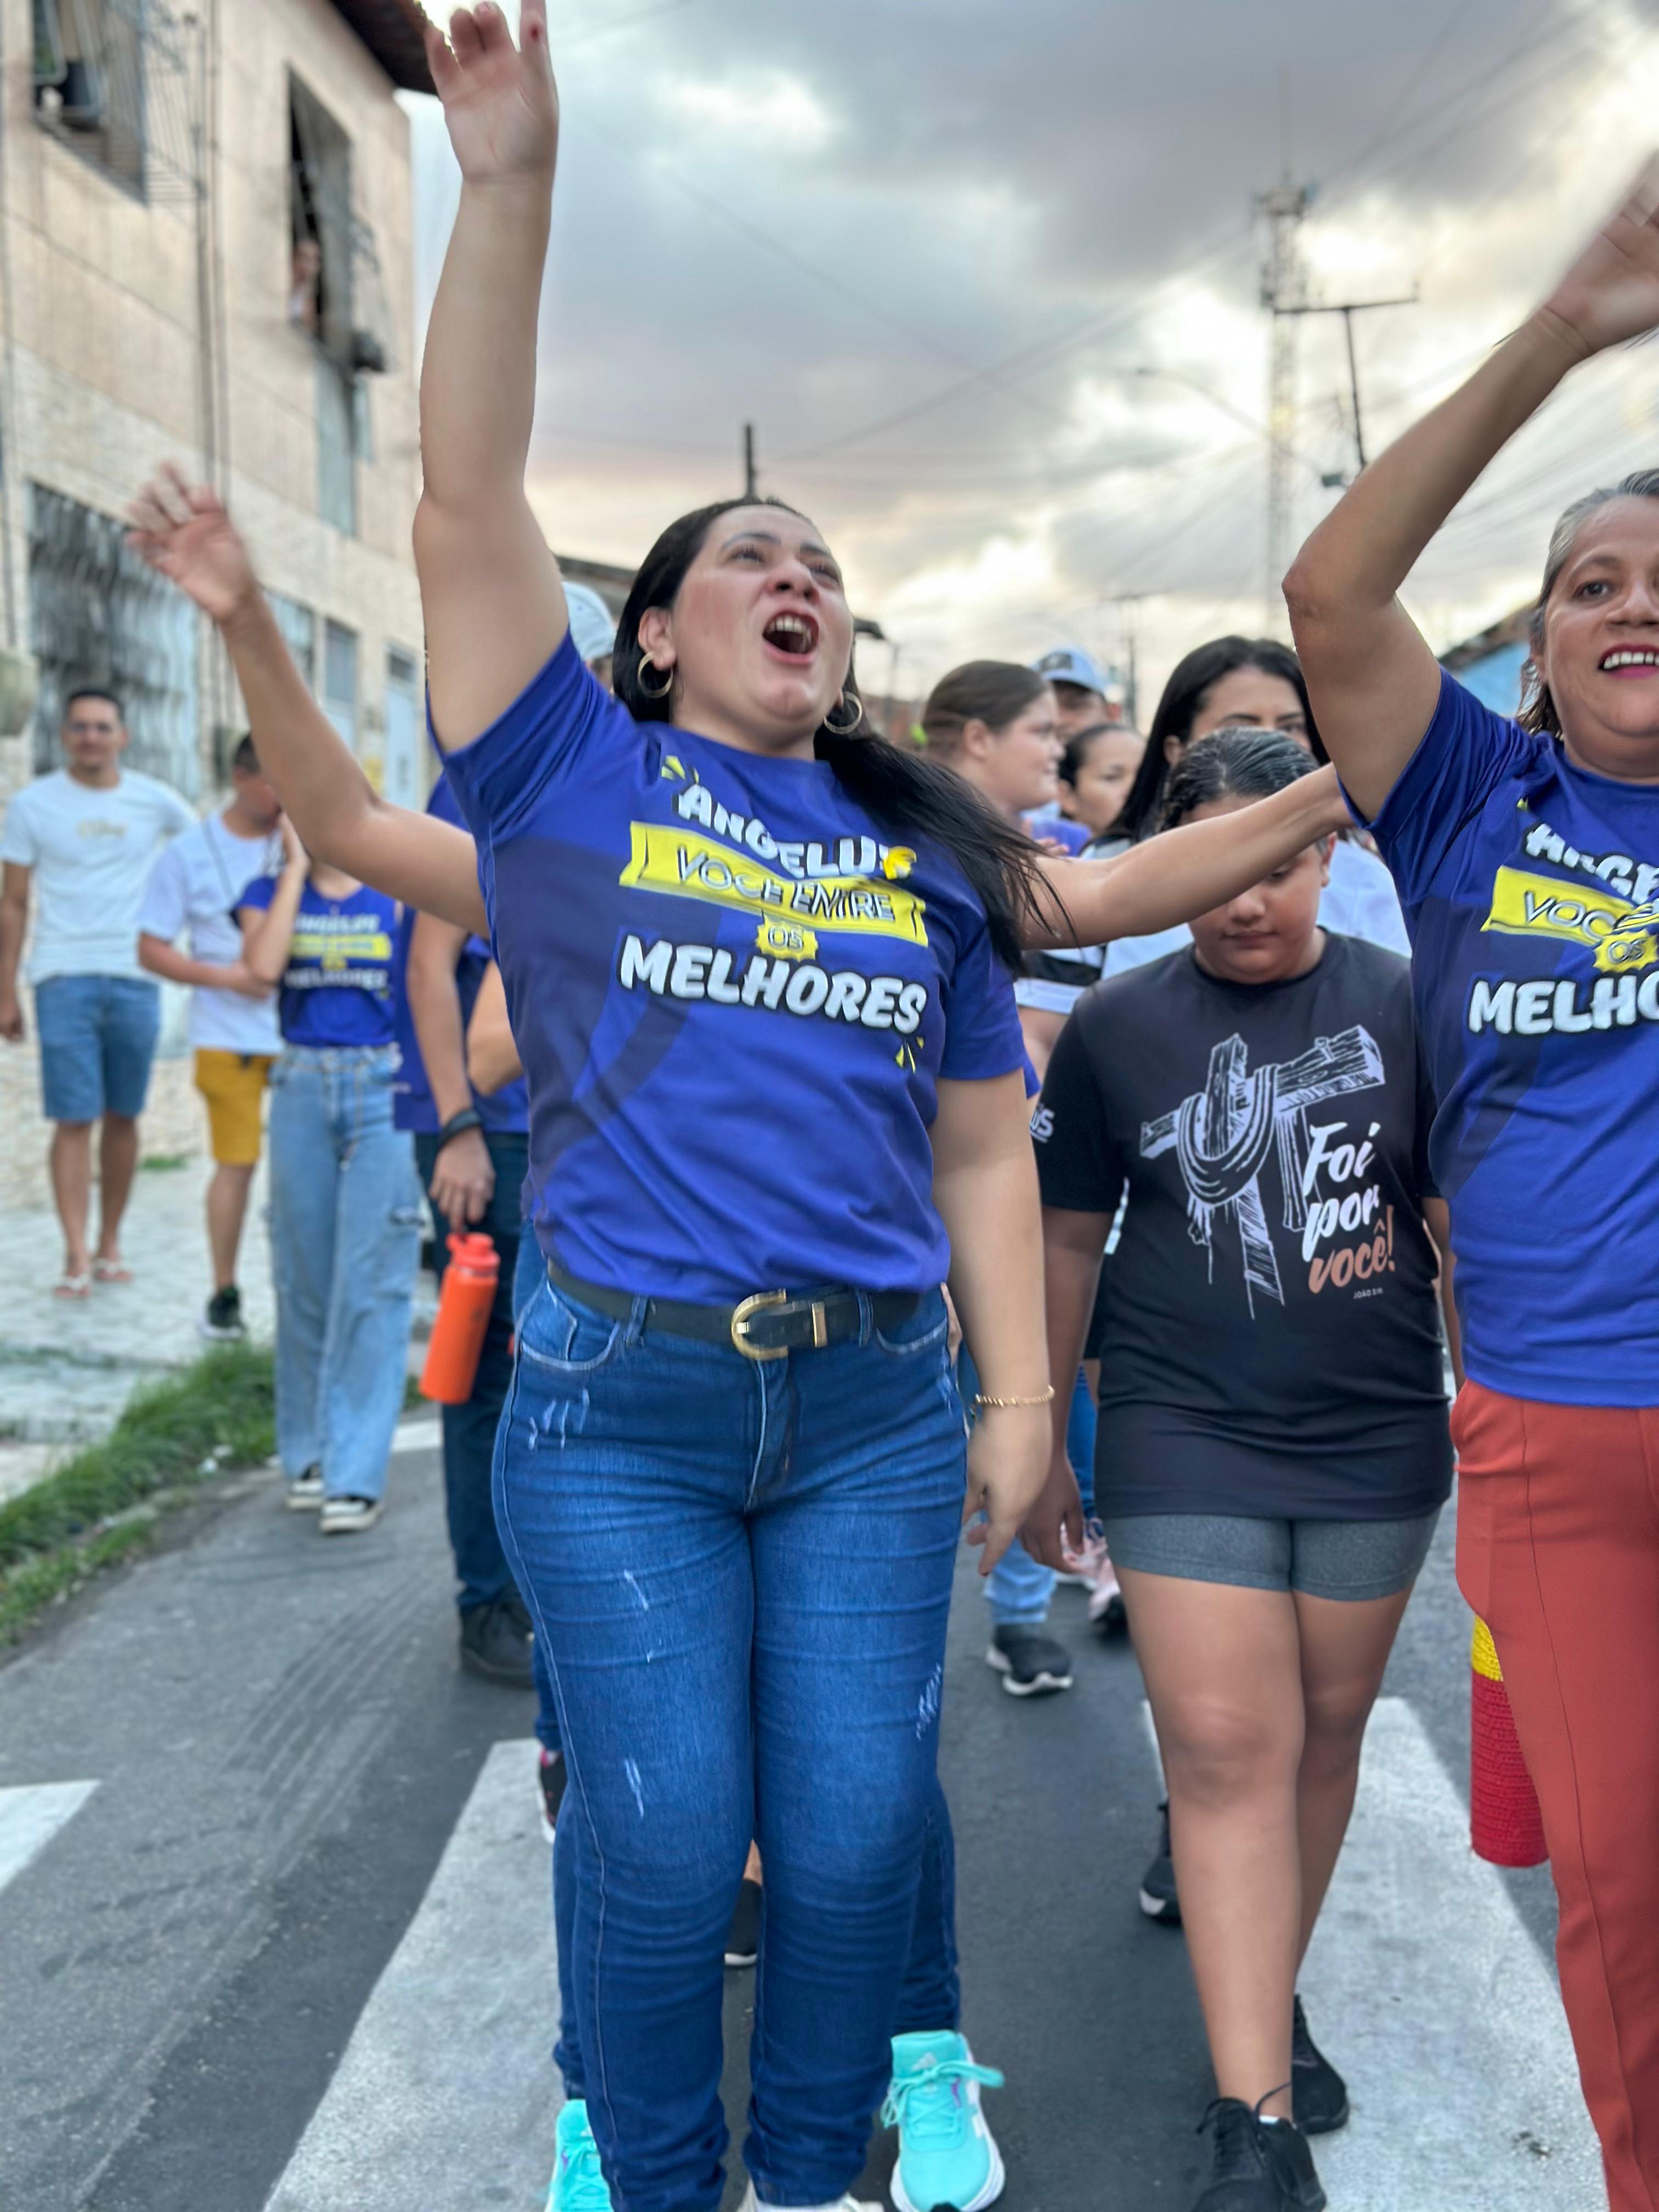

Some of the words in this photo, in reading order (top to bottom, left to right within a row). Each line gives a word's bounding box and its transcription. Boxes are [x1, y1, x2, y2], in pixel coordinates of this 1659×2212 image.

[678, 784, 889, 879] ANGELU
[769, 926, 803, 951] OS
[1525, 890, 1616, 941] VOC
[620, 935, 927, 1034] MELHORES
[1302, 1122, 1381, 1197] Foi
[1302, 1184, 1380, 1262] por
[1308, 1205, 1395, 1294] você!
